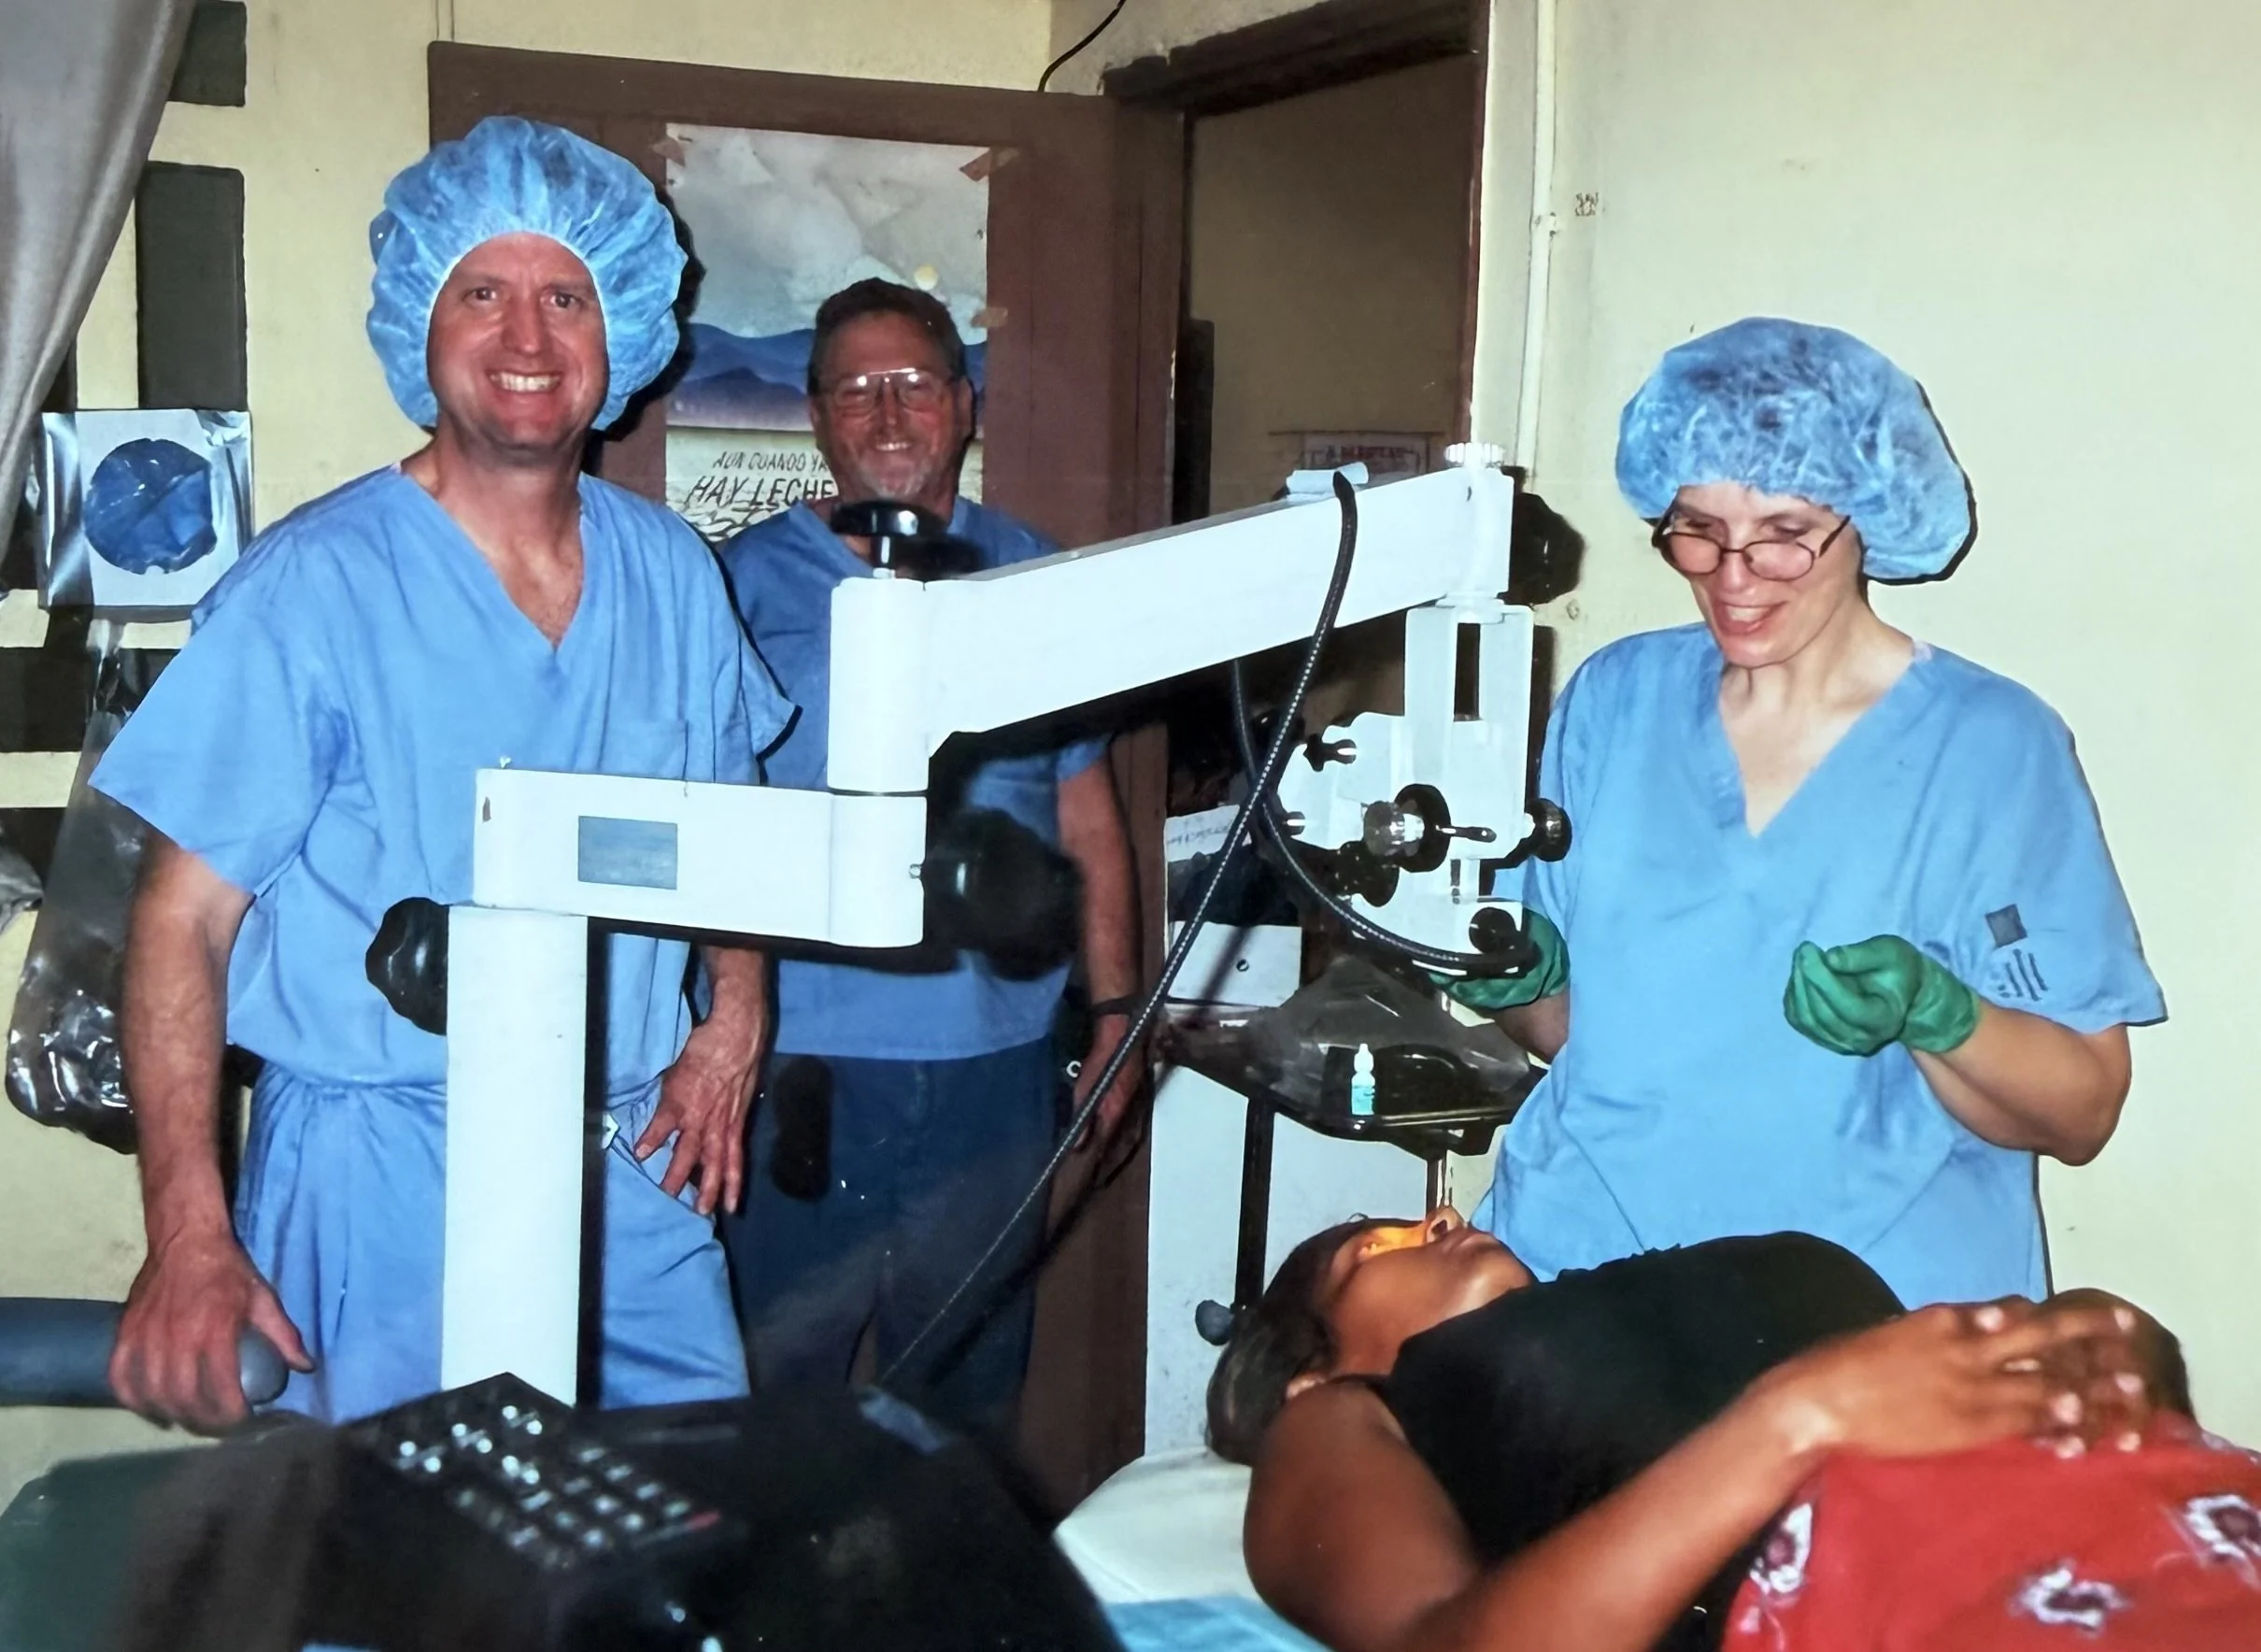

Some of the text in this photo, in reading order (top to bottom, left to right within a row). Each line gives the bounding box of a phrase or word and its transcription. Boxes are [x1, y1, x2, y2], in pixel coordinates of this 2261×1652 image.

[748, 452, 806, 470] CUANDO
[684, 476, 834, 508] HAY LECHE
